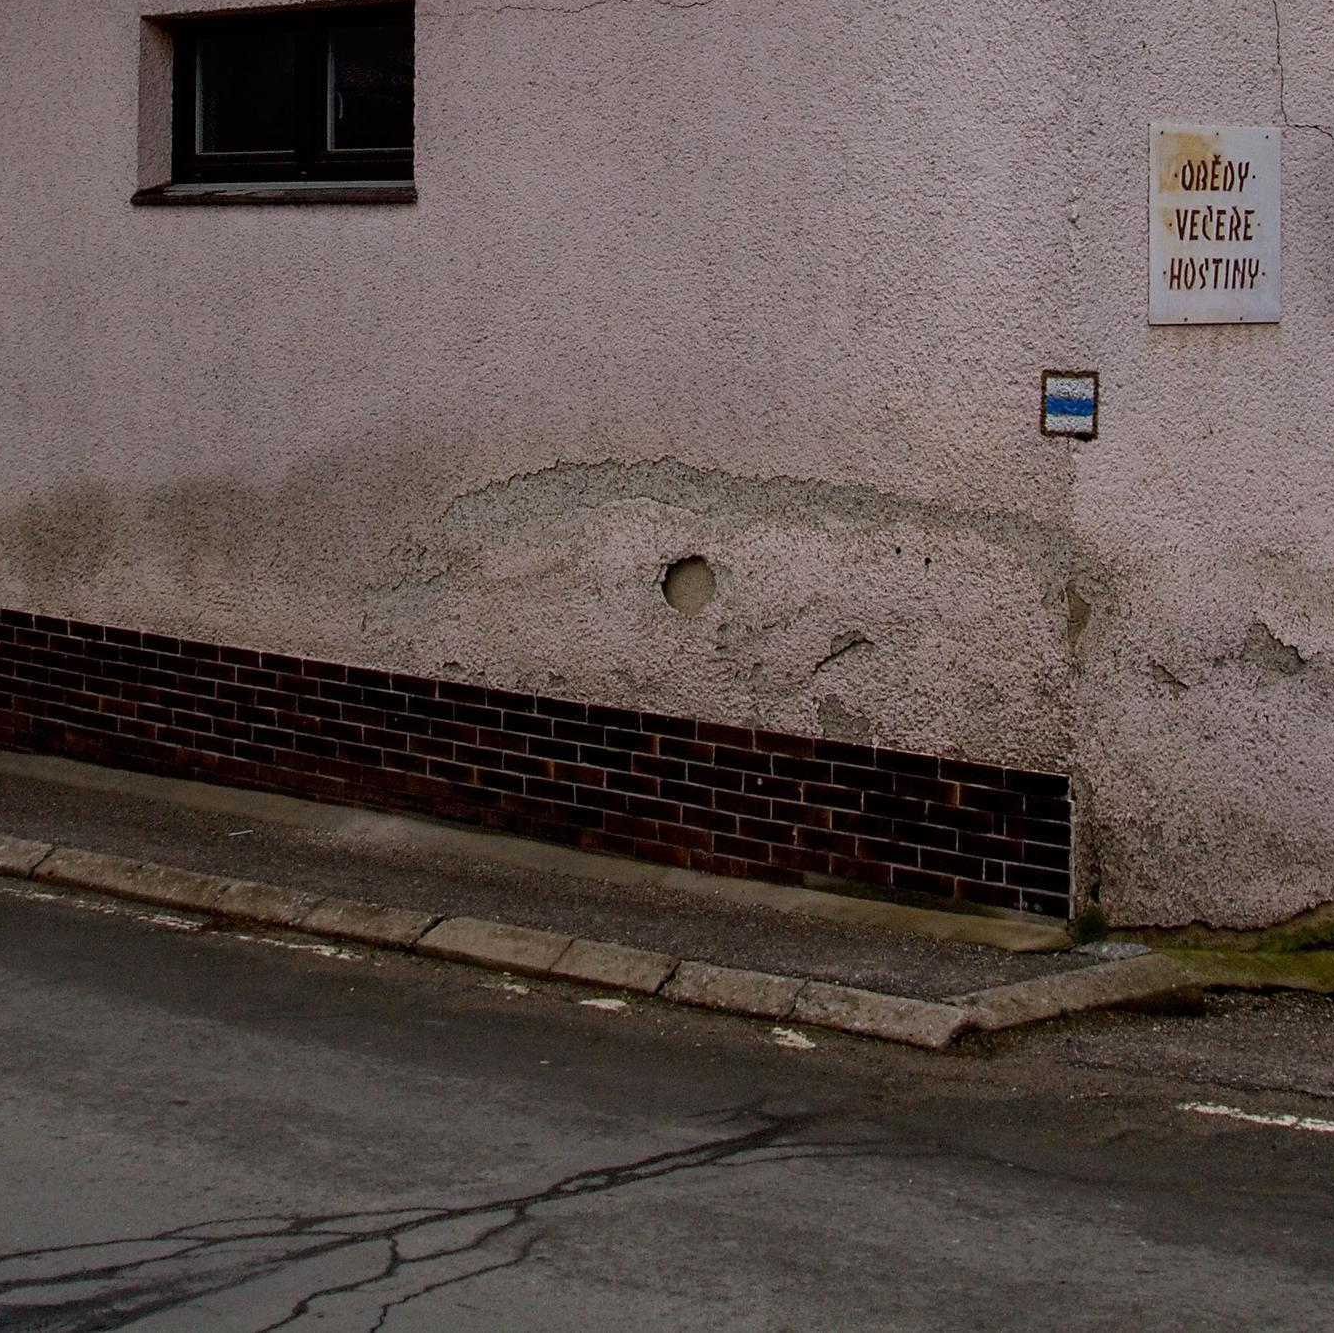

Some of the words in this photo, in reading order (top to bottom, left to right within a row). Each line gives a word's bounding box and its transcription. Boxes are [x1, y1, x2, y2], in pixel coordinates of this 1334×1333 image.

[1180, 154, 1250, 192] OBĚDY
[1176, 205, 1255, 241] VEČEŘE
[1169, 258, 1260, 290] HOSTINY
